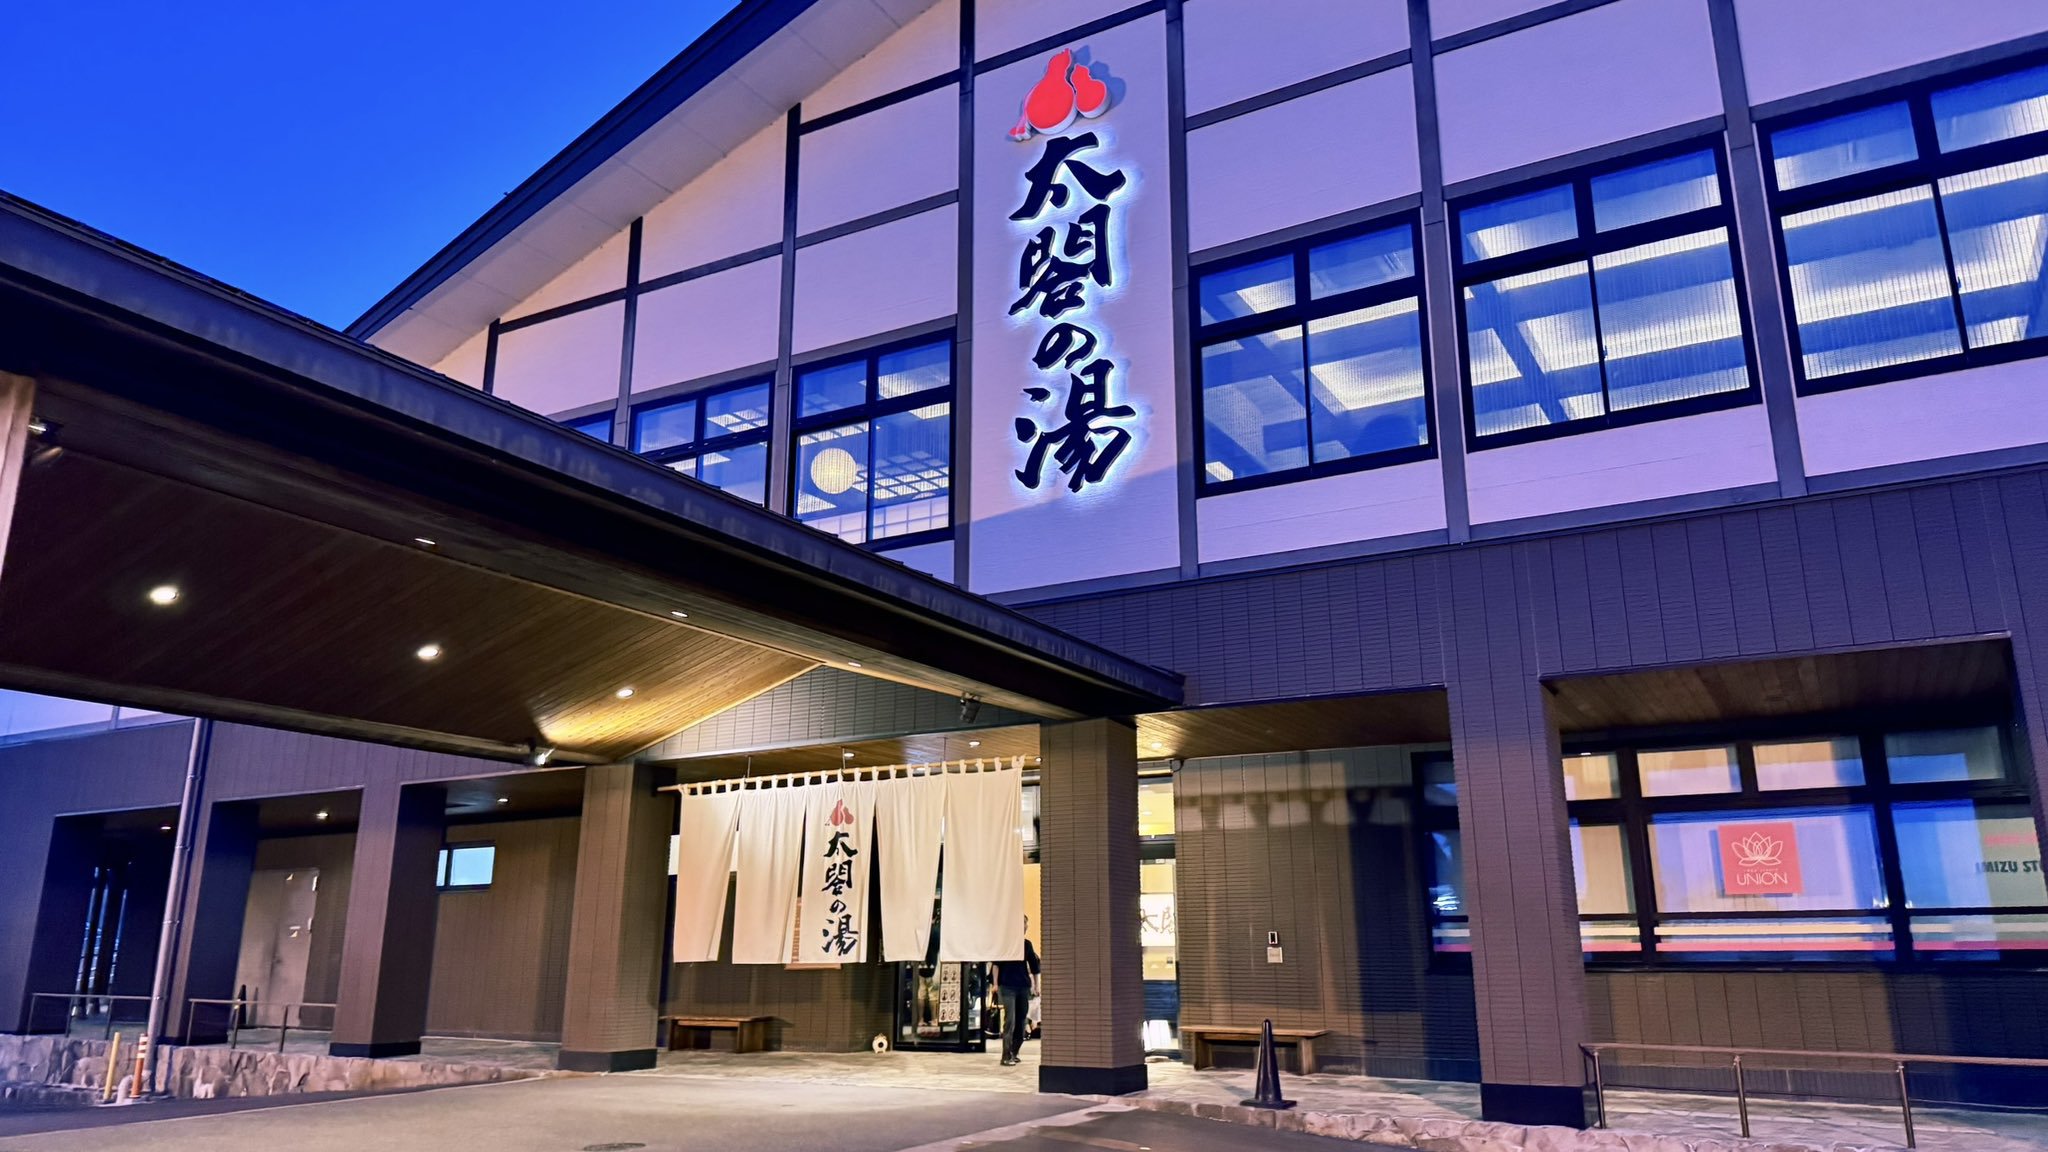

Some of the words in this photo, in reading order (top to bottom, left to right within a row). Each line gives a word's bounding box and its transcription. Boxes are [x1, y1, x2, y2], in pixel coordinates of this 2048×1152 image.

[1009, 131, 1136, 493] 太閤の湯
[822, 831, 858, 956] 太閤の湯
[1736, 871, 1788, 886] UNION
